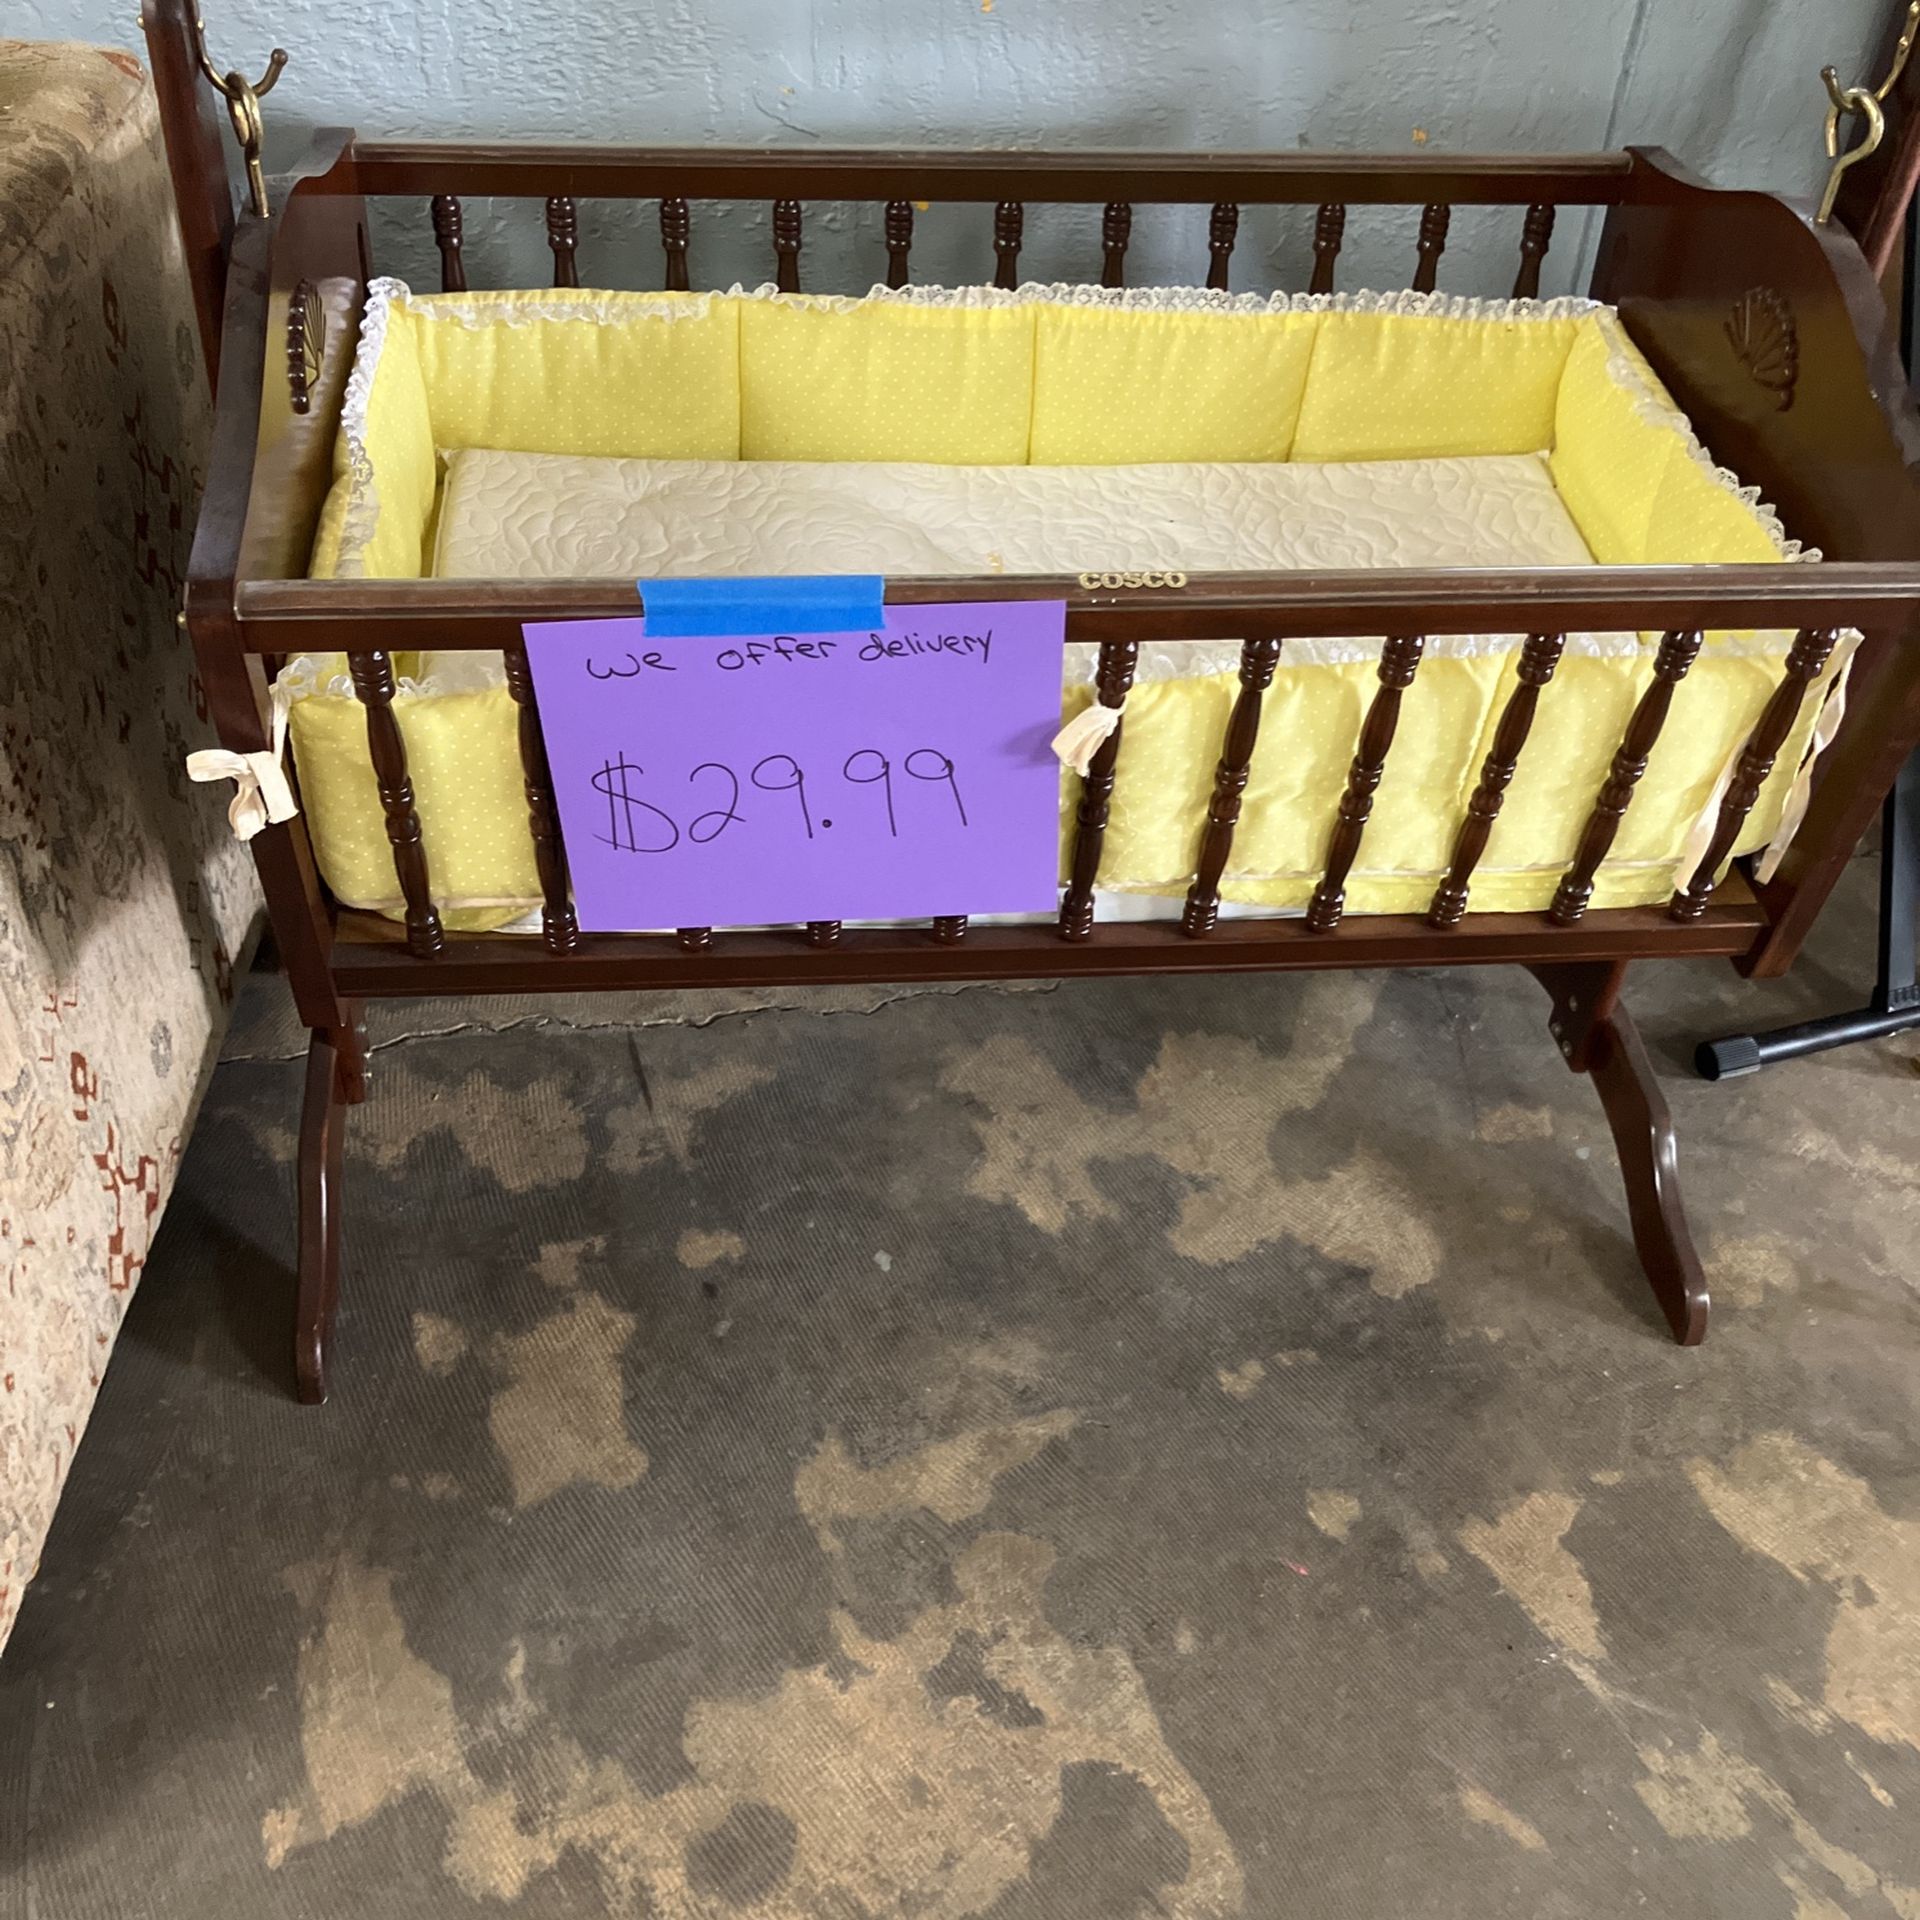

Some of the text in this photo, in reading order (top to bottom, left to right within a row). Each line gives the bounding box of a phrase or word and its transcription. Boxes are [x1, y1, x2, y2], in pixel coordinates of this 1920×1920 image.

[1078, 571, 1188, 590] COSCO
[716, 636, 837, 671] offer
[858, 629, 993, 664] delivery
[591, 748, 968, 853] $29.99
